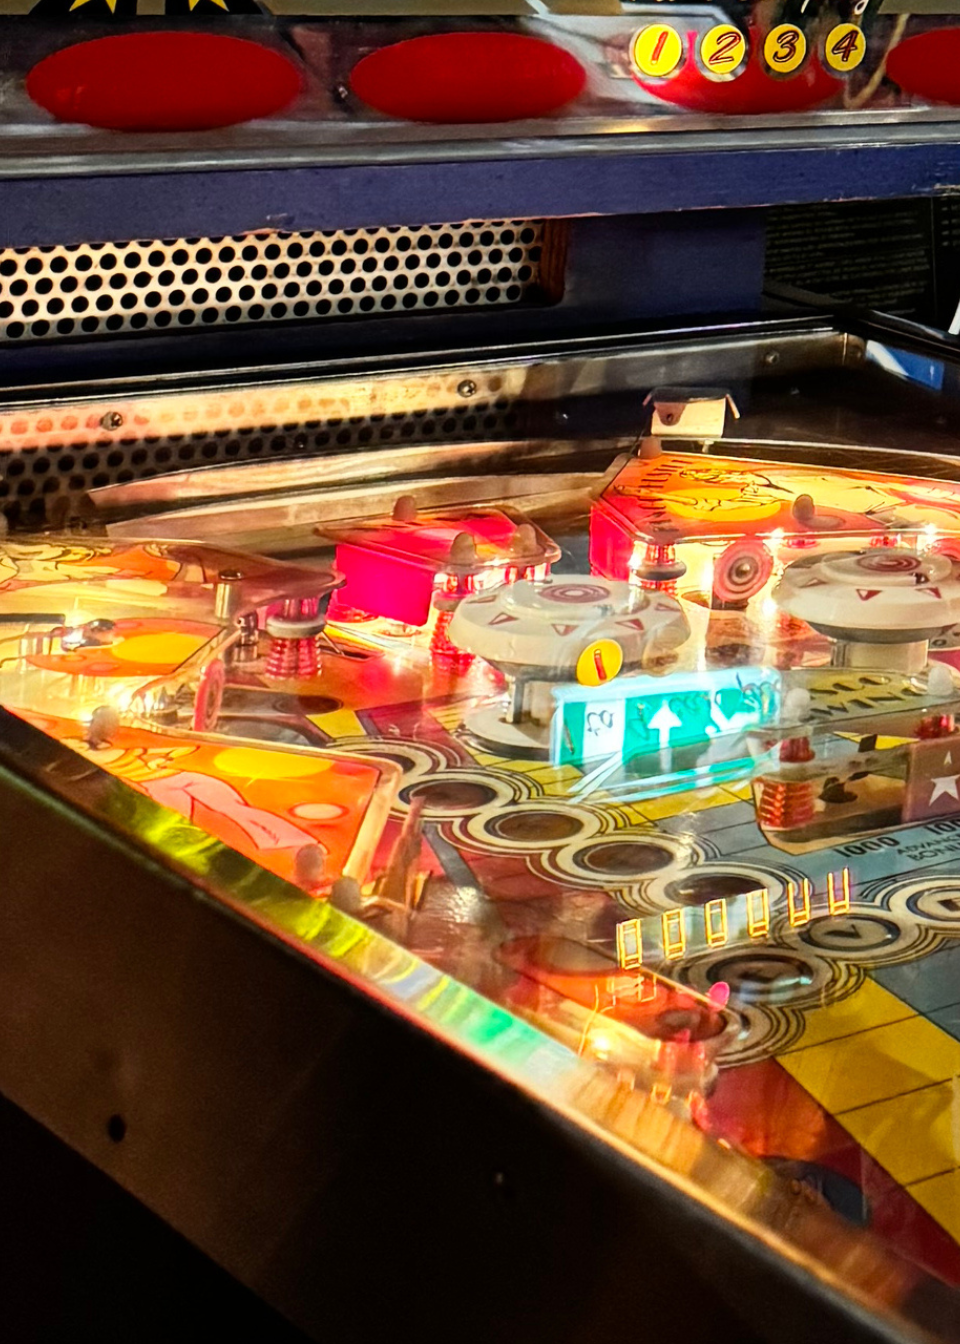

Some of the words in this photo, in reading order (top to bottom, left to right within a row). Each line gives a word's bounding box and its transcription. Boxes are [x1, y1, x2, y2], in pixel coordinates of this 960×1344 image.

[650, 31, 669, 66] 1
[708, 30, 742, 64] 2
[772, 28, 802, 62] 3
[832, 28, 859, 61] 4
[832, 835, 901, 858] 1000
